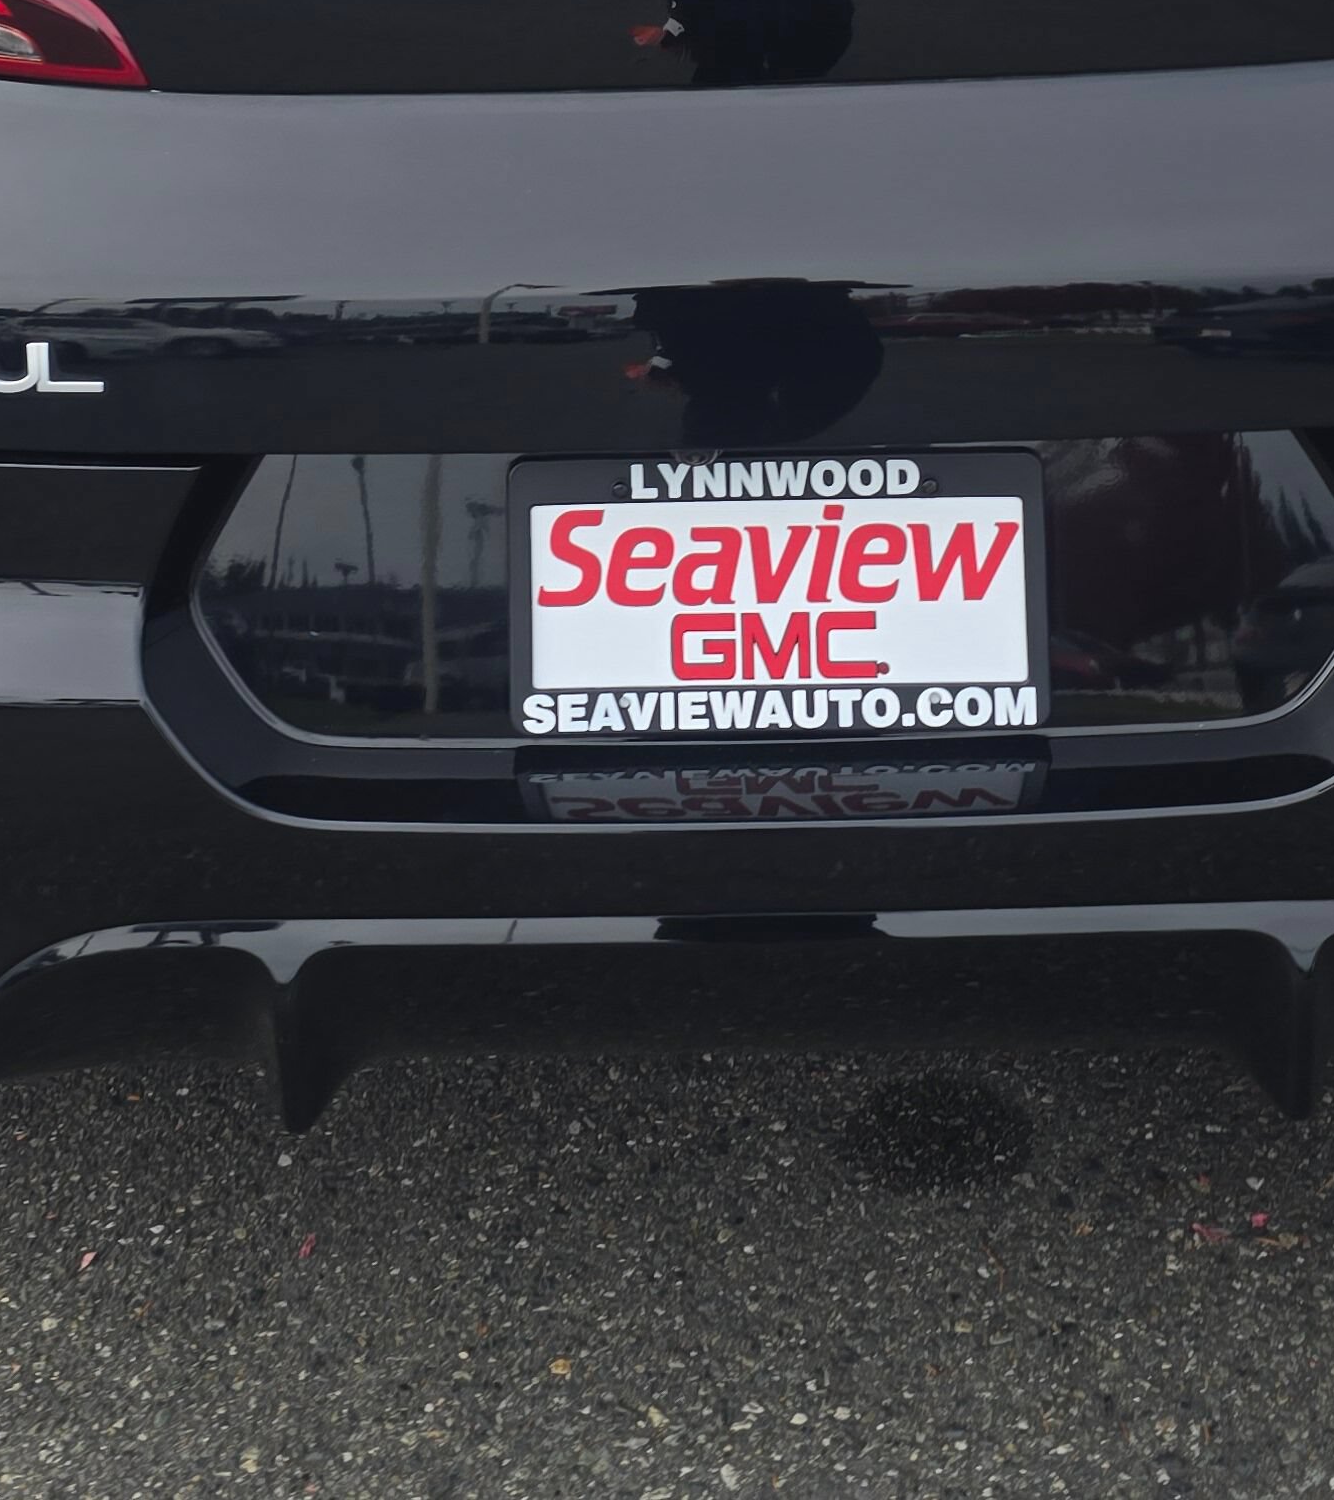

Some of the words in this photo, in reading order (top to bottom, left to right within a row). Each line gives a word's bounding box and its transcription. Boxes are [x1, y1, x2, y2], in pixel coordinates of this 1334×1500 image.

[629, 458, 920, 500] LYNNWOOD
[537, 504, 1020, 608] Seaview
[670, 610, 878, 681] GMC
[521, 686, 1038, 735] SEAVIEWAUTO.COM
